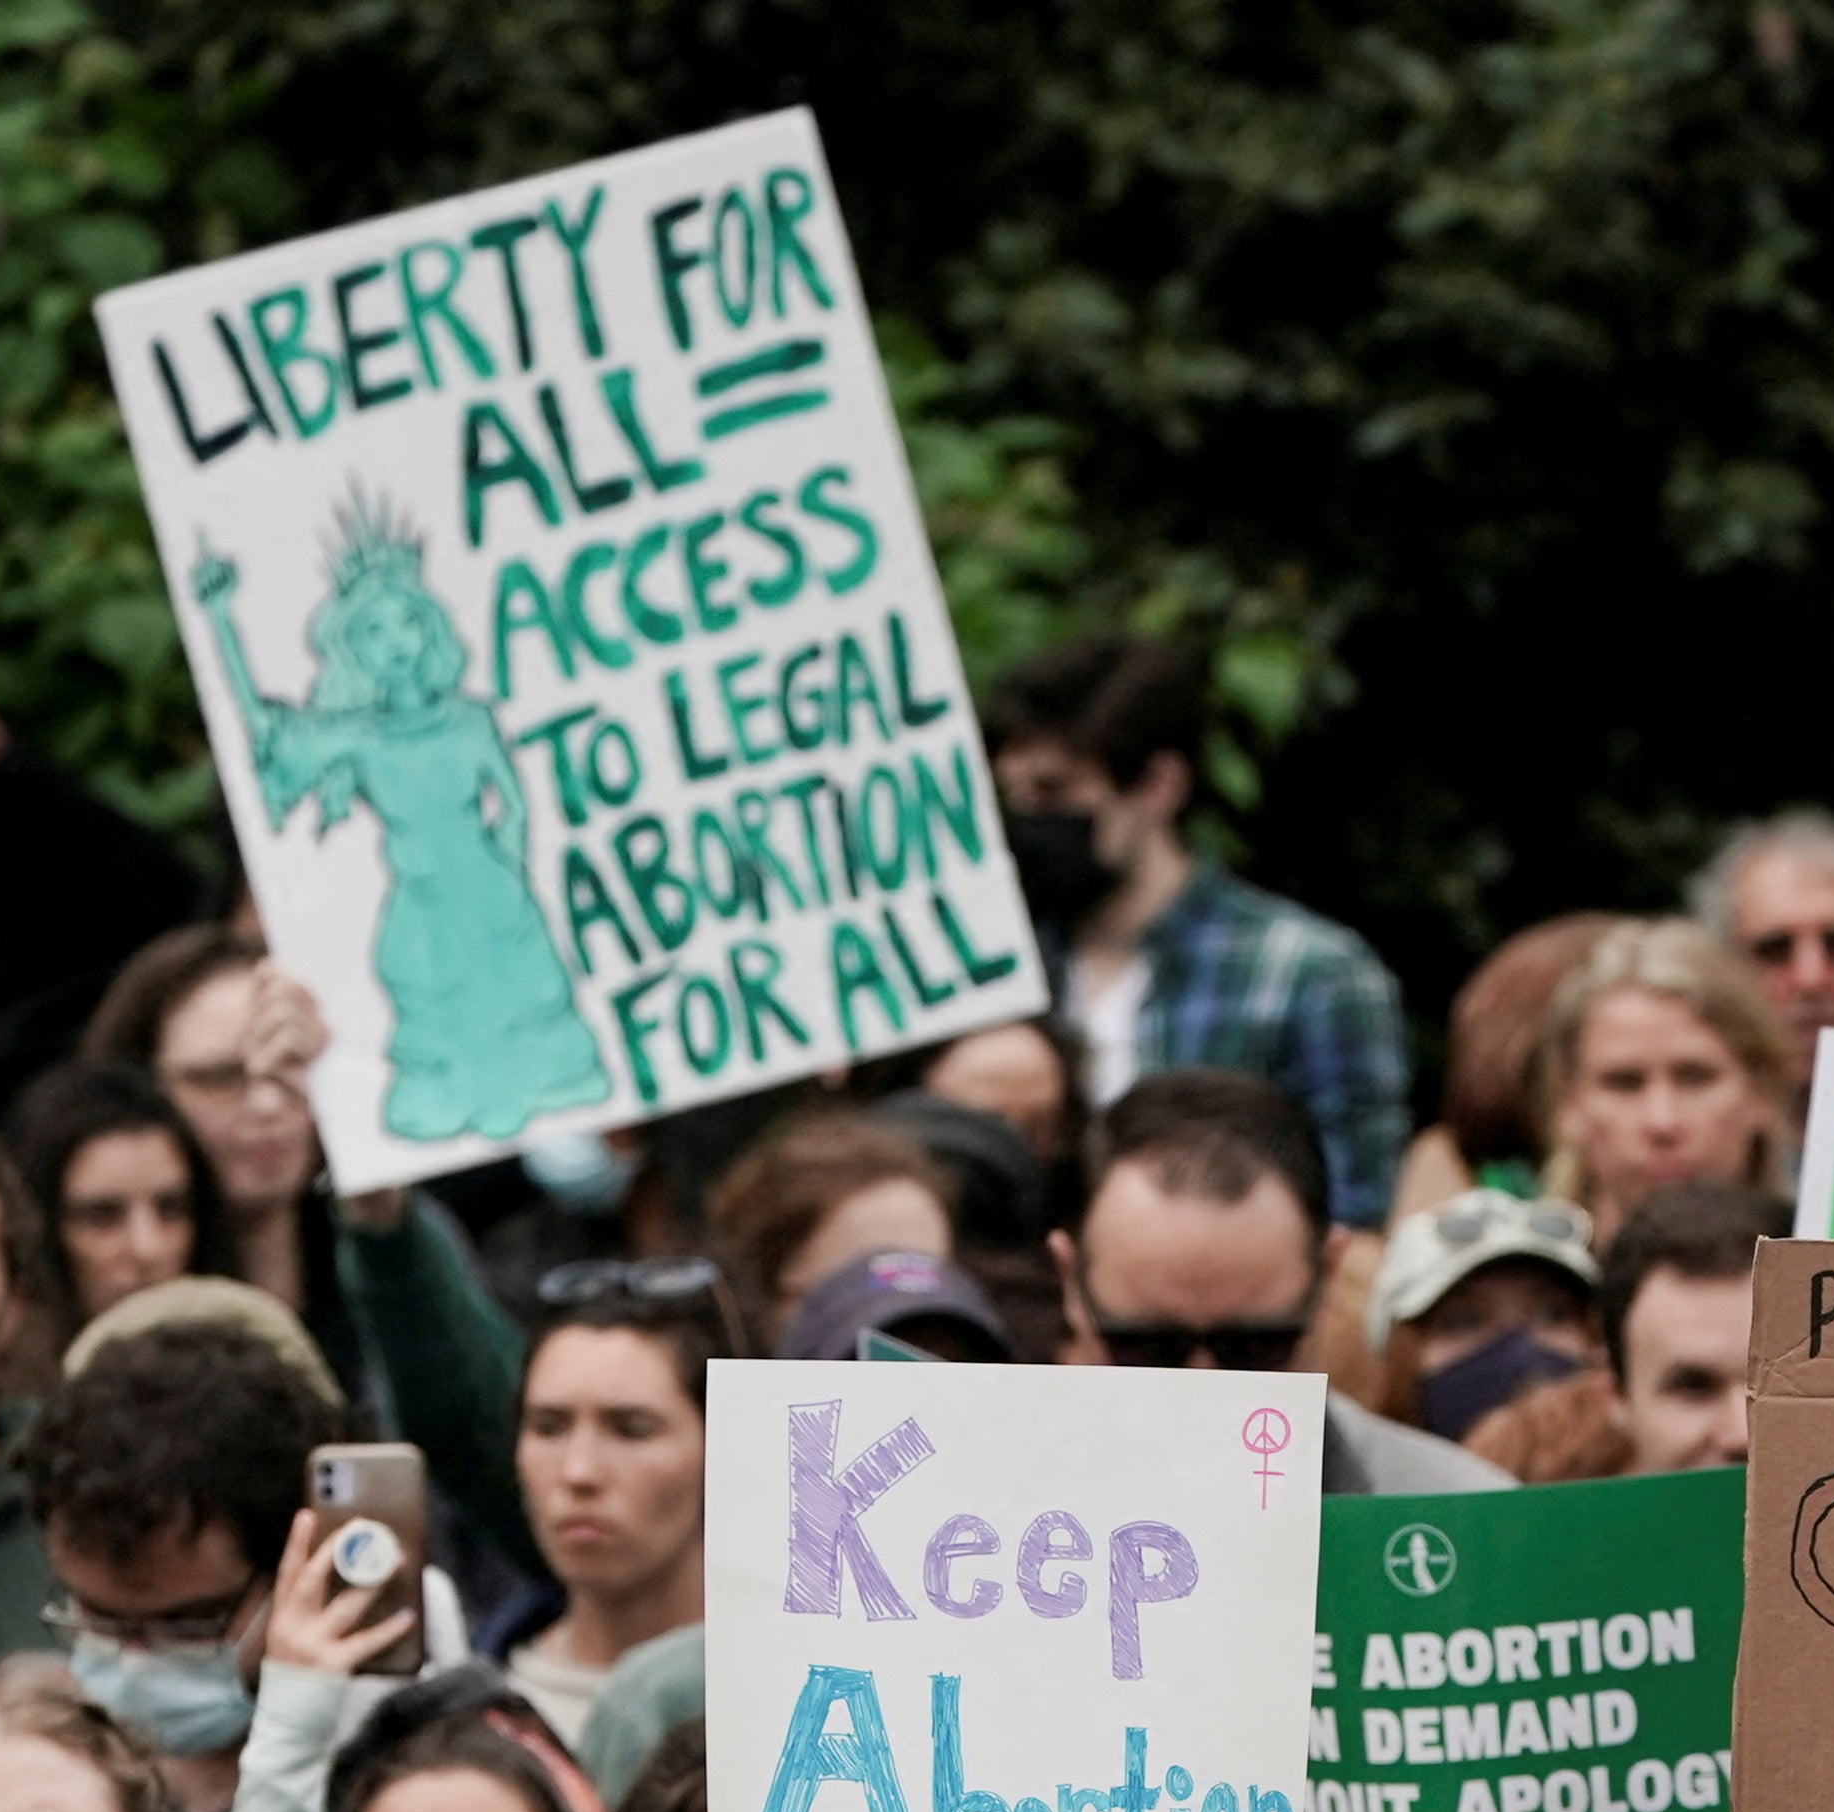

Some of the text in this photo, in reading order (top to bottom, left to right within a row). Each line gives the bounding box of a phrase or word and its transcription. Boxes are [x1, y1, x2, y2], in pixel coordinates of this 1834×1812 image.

[151, 168, 834, 463] LIBERTY FOR
[495, 465, 878, 699] ACCESS
[517, 613, 948, 826] TO LEGAL
[563, 745, 983, 975] ABORTION
[610, 894, 1018, 1104] FOR ALL
[783, 1399, 1201, 1680] Keep
[1361, 1607, 1696, 1690] ABORTION
[1362, 1688, 1638, 1765] DEMAND
